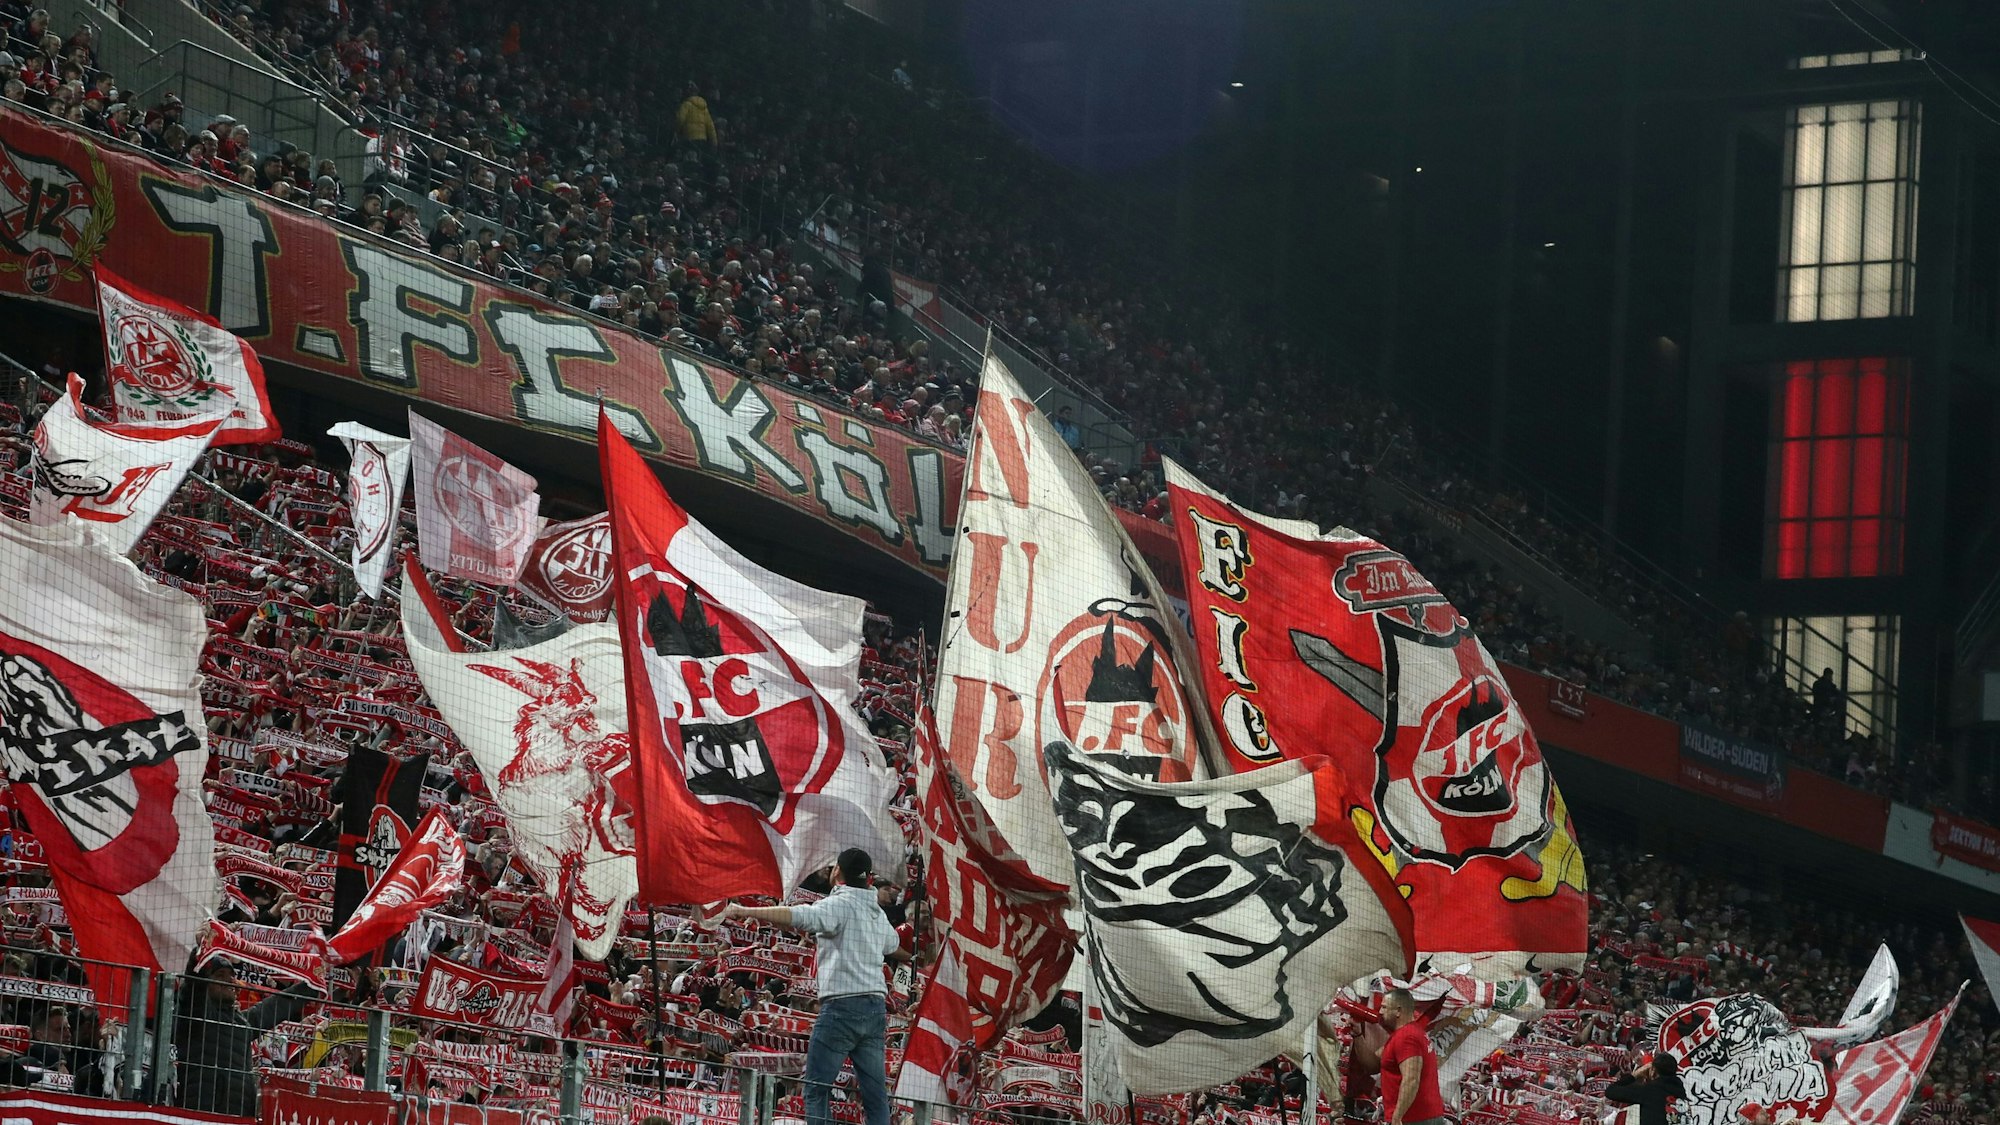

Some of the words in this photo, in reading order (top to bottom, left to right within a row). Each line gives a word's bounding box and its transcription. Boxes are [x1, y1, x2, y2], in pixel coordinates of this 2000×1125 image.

[25, 177, 71, 237] 12
[126, 407, 147, 420] 1948
[661, 346, 953, 568] KÖL
[1441, 712, 1509, 776] 1.FC
[1444, 764, 1503, 799] KÖLN
[41, 986, 88, 1002] ESSEN
[1676, 1018, 1715, 1057] 1.FC
